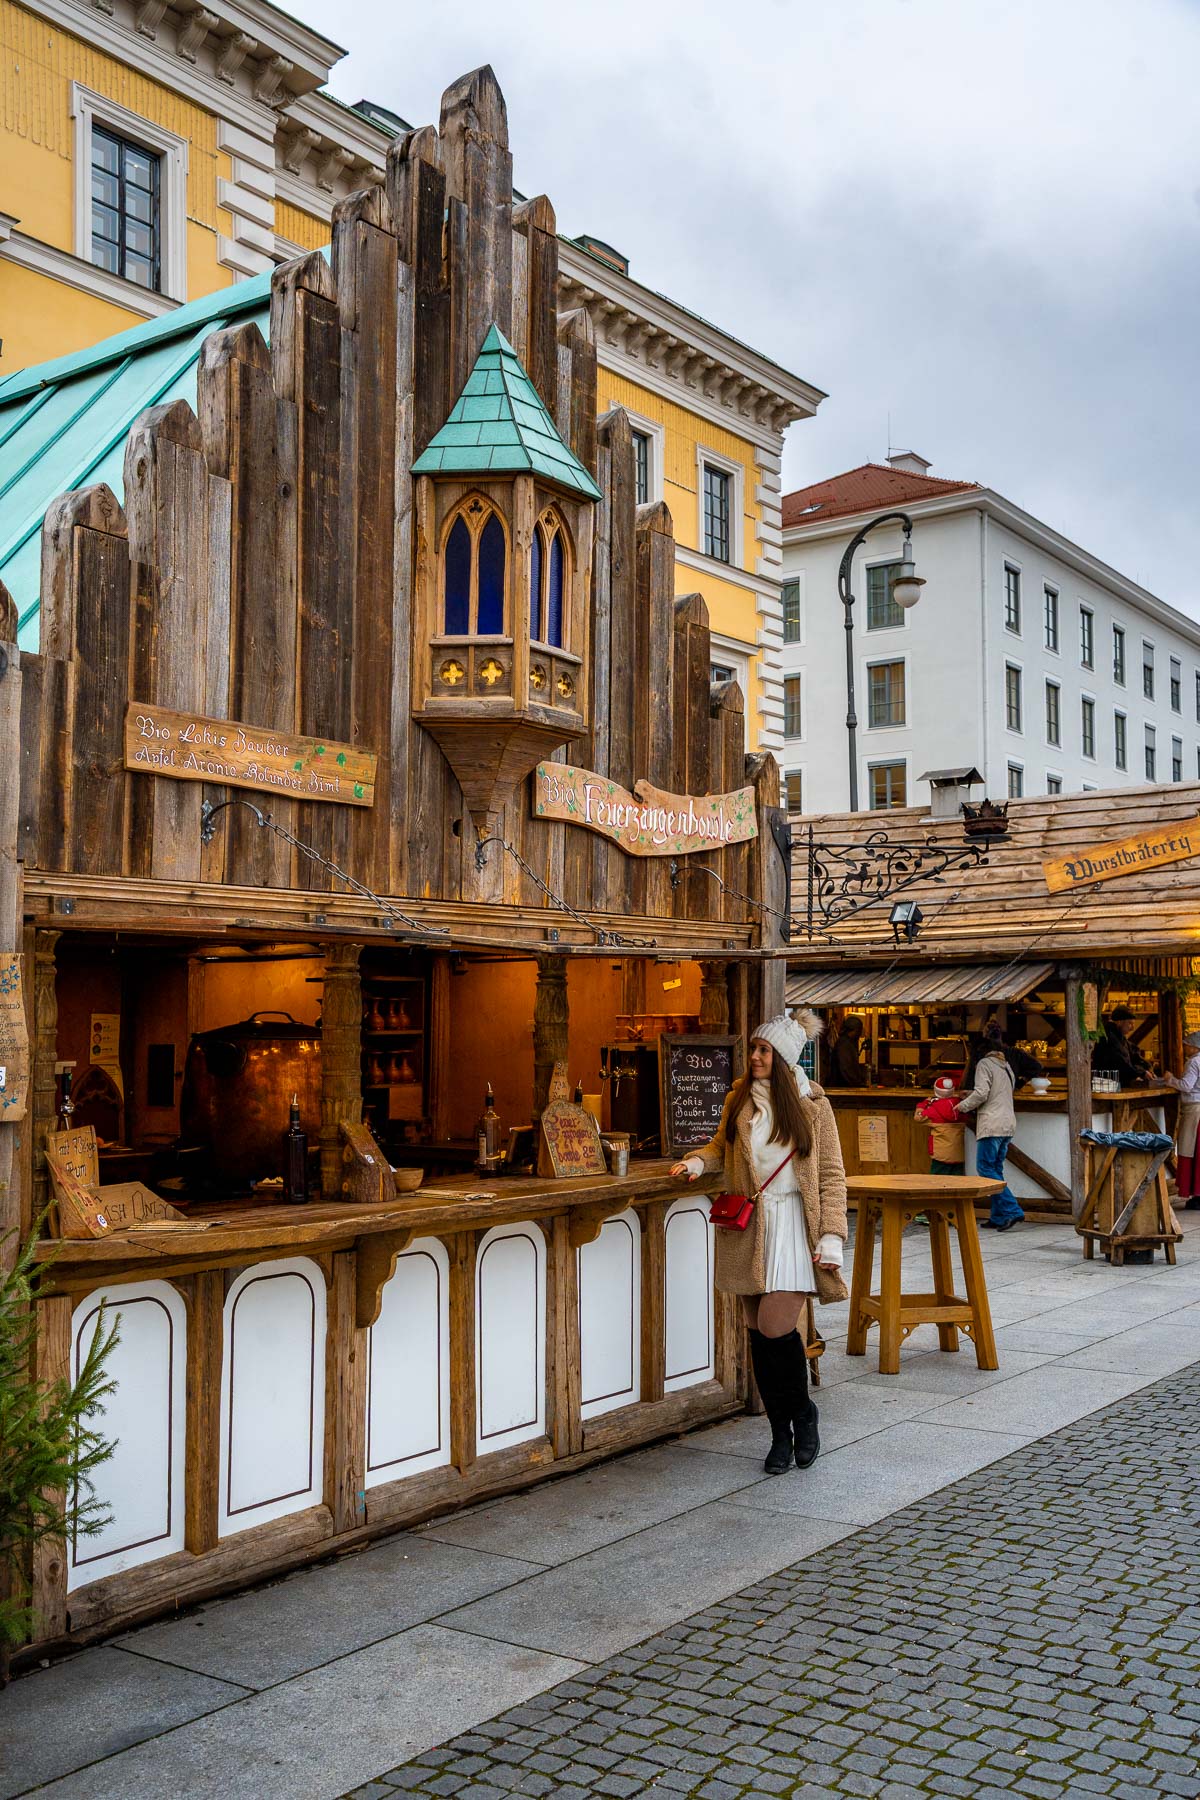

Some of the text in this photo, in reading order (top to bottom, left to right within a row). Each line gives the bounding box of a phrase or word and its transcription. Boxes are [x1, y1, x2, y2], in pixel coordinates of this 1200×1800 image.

[136, 715, 170, 740] Bio
[179, 723, 227, 747] Lokis
[542, 775, 734, 845] Bio Feuerzangenbowle
[686, 1054, 713, 1068] Bio
[672, 1096, 703, 1106] Lokis
